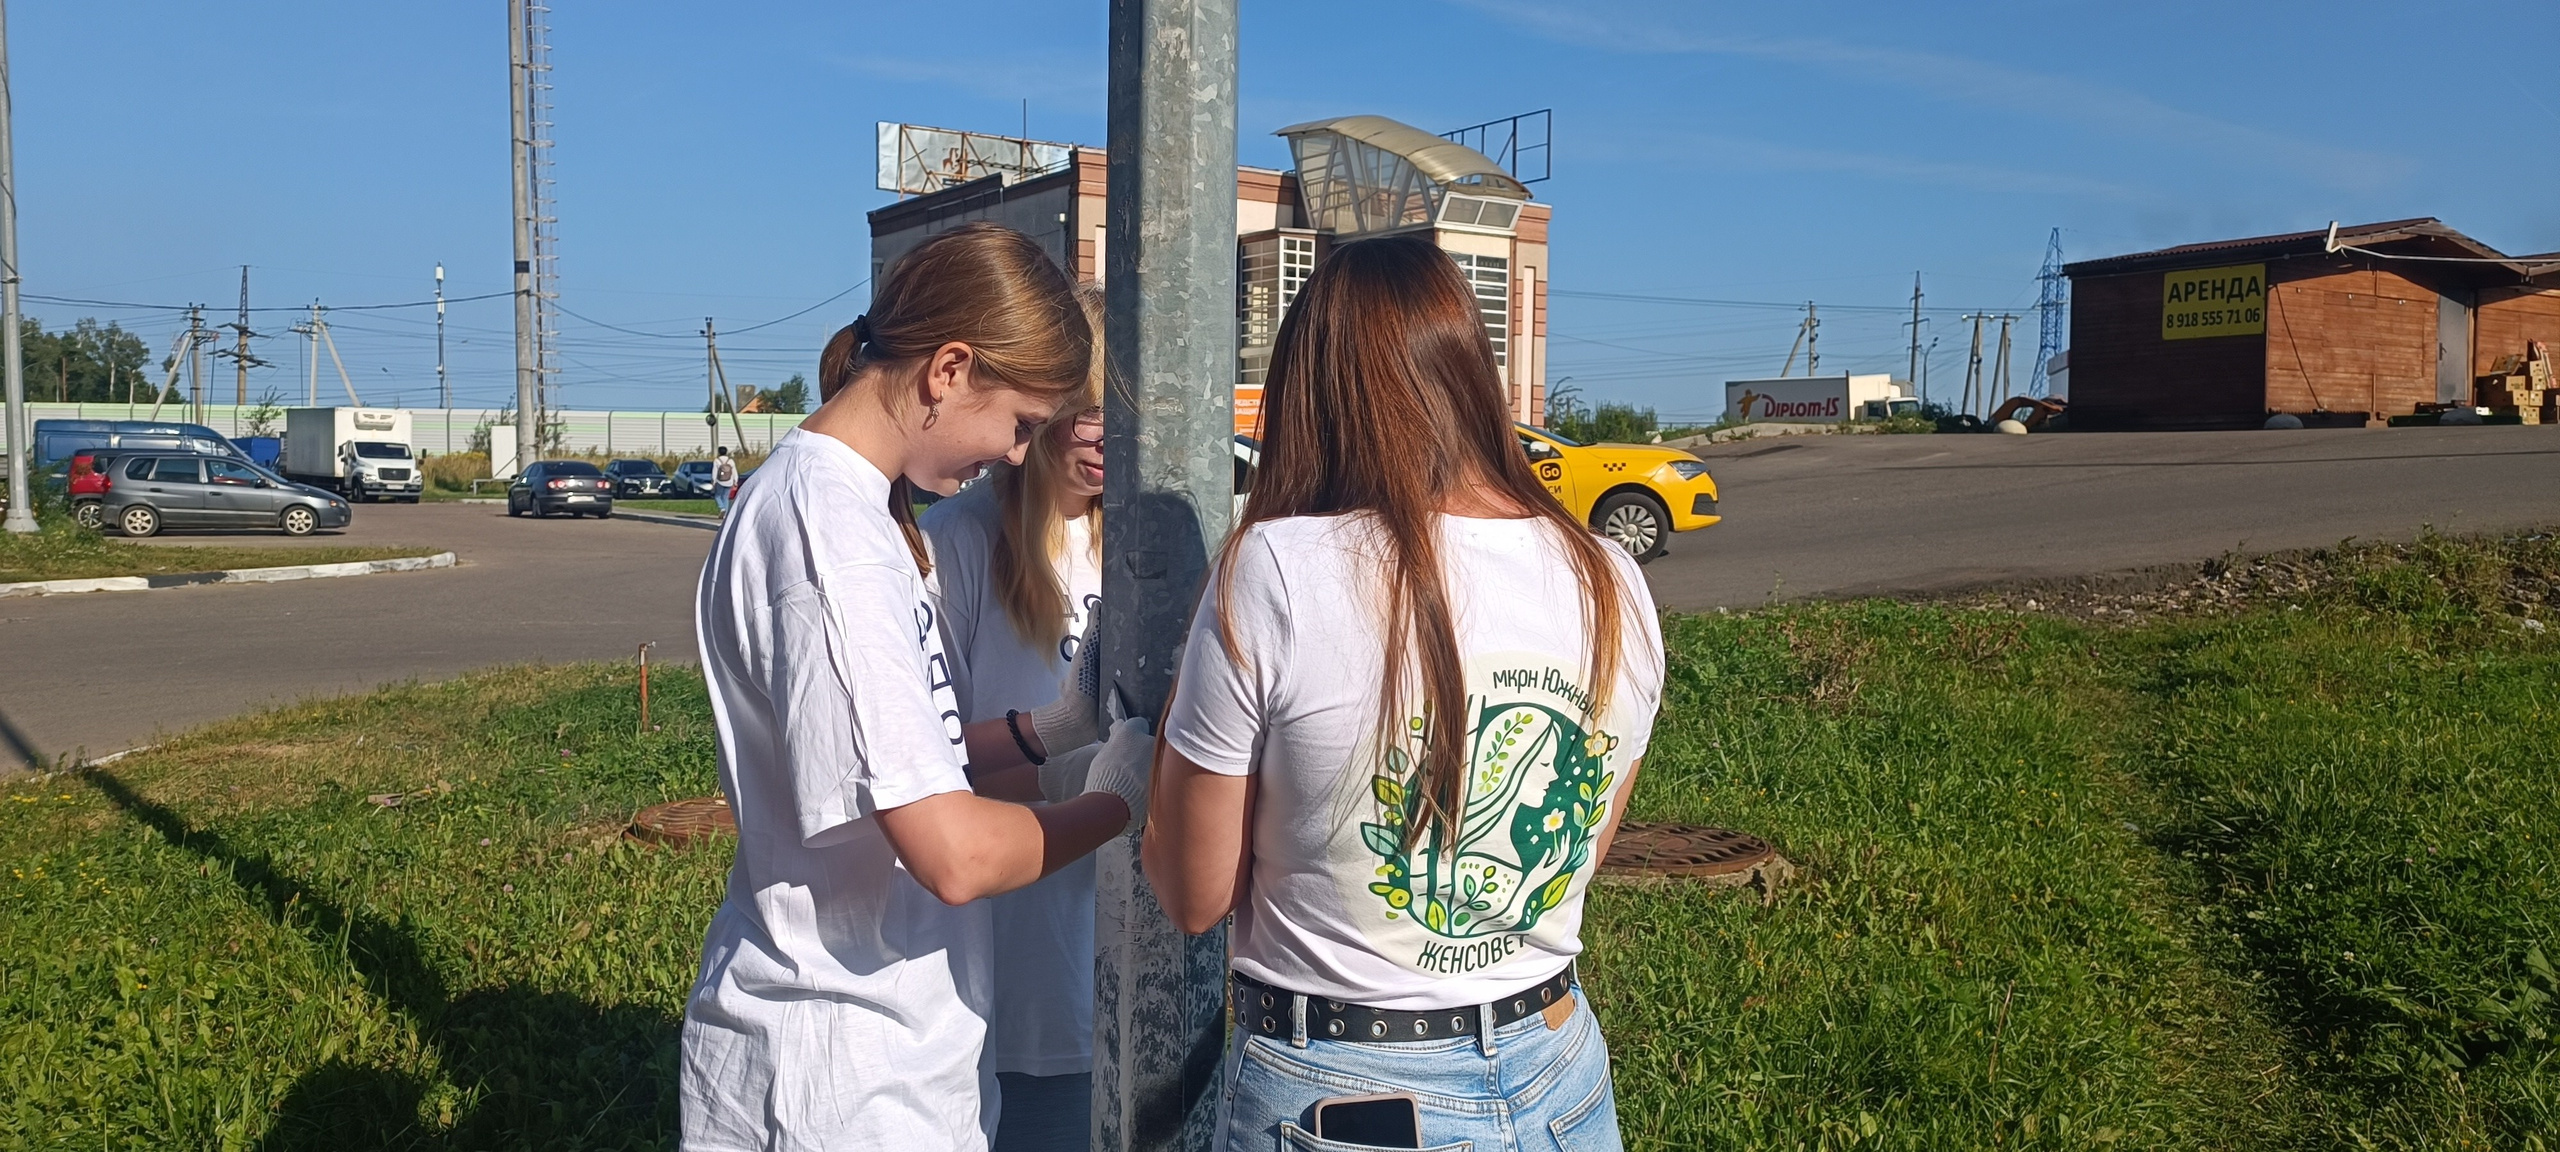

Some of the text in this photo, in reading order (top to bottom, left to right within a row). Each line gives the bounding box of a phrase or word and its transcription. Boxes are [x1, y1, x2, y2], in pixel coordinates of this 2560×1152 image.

[2167, 275, 2261, 304] АРЕНДА
[2166, 307, 2260, 328] 8 918 555 71 06
[1541, 465, 1560, 478] Go
[1493, 669, 1538, 693] мкрн
[1416, 933, 1530, 974] ЖЕНСОВЕТ
